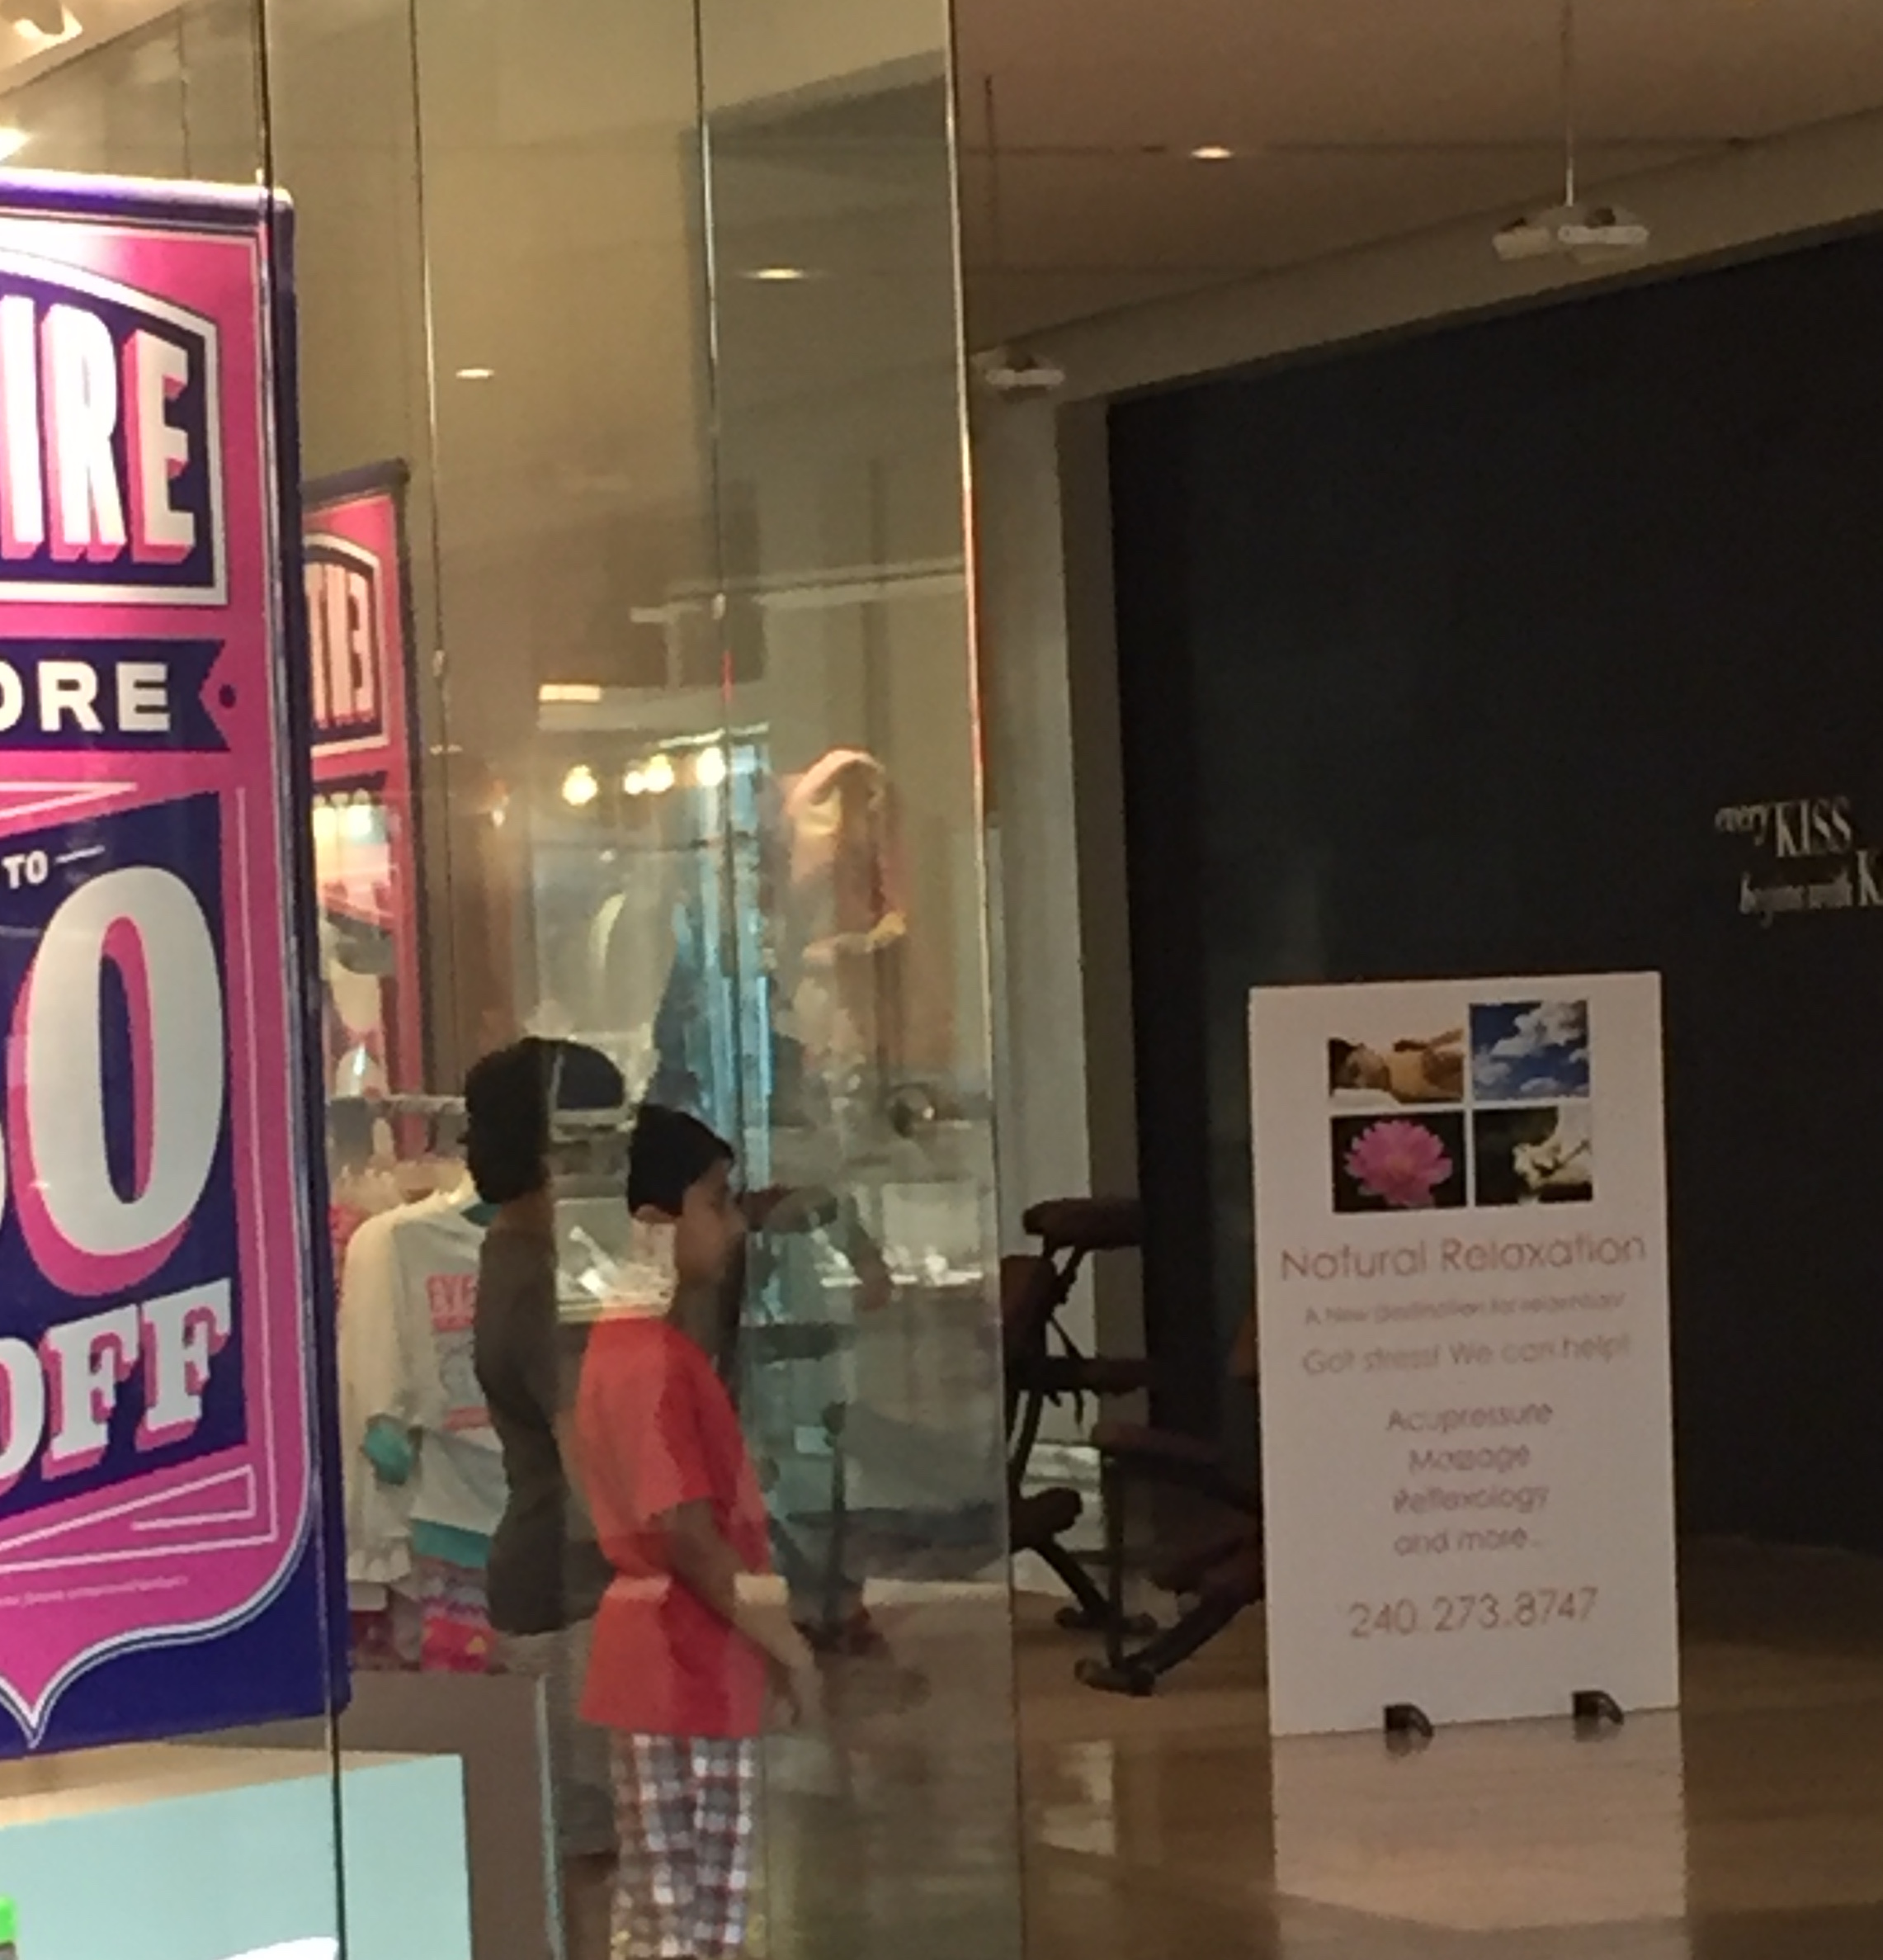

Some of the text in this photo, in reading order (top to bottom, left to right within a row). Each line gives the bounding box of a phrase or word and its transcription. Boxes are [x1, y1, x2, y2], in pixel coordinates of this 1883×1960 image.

[1775, 797, 1851, 857] KISS
[2, 850, 49, 890] TO
[0, 866, 224, 1297] 0
[1280, 1234, 1646, 1281] Natural Relaxation
[1449, 1339, 1494, 1365] We
[1500, 1337, 1555, 1364] can
[1385, 1403, 1553, 1433] Acupressure
[1408, 1444, 1530, 1474] Massage
[1393, 1485, 1550, 1515] Reflexology
[1394, 1531, 1449, 1556] and
